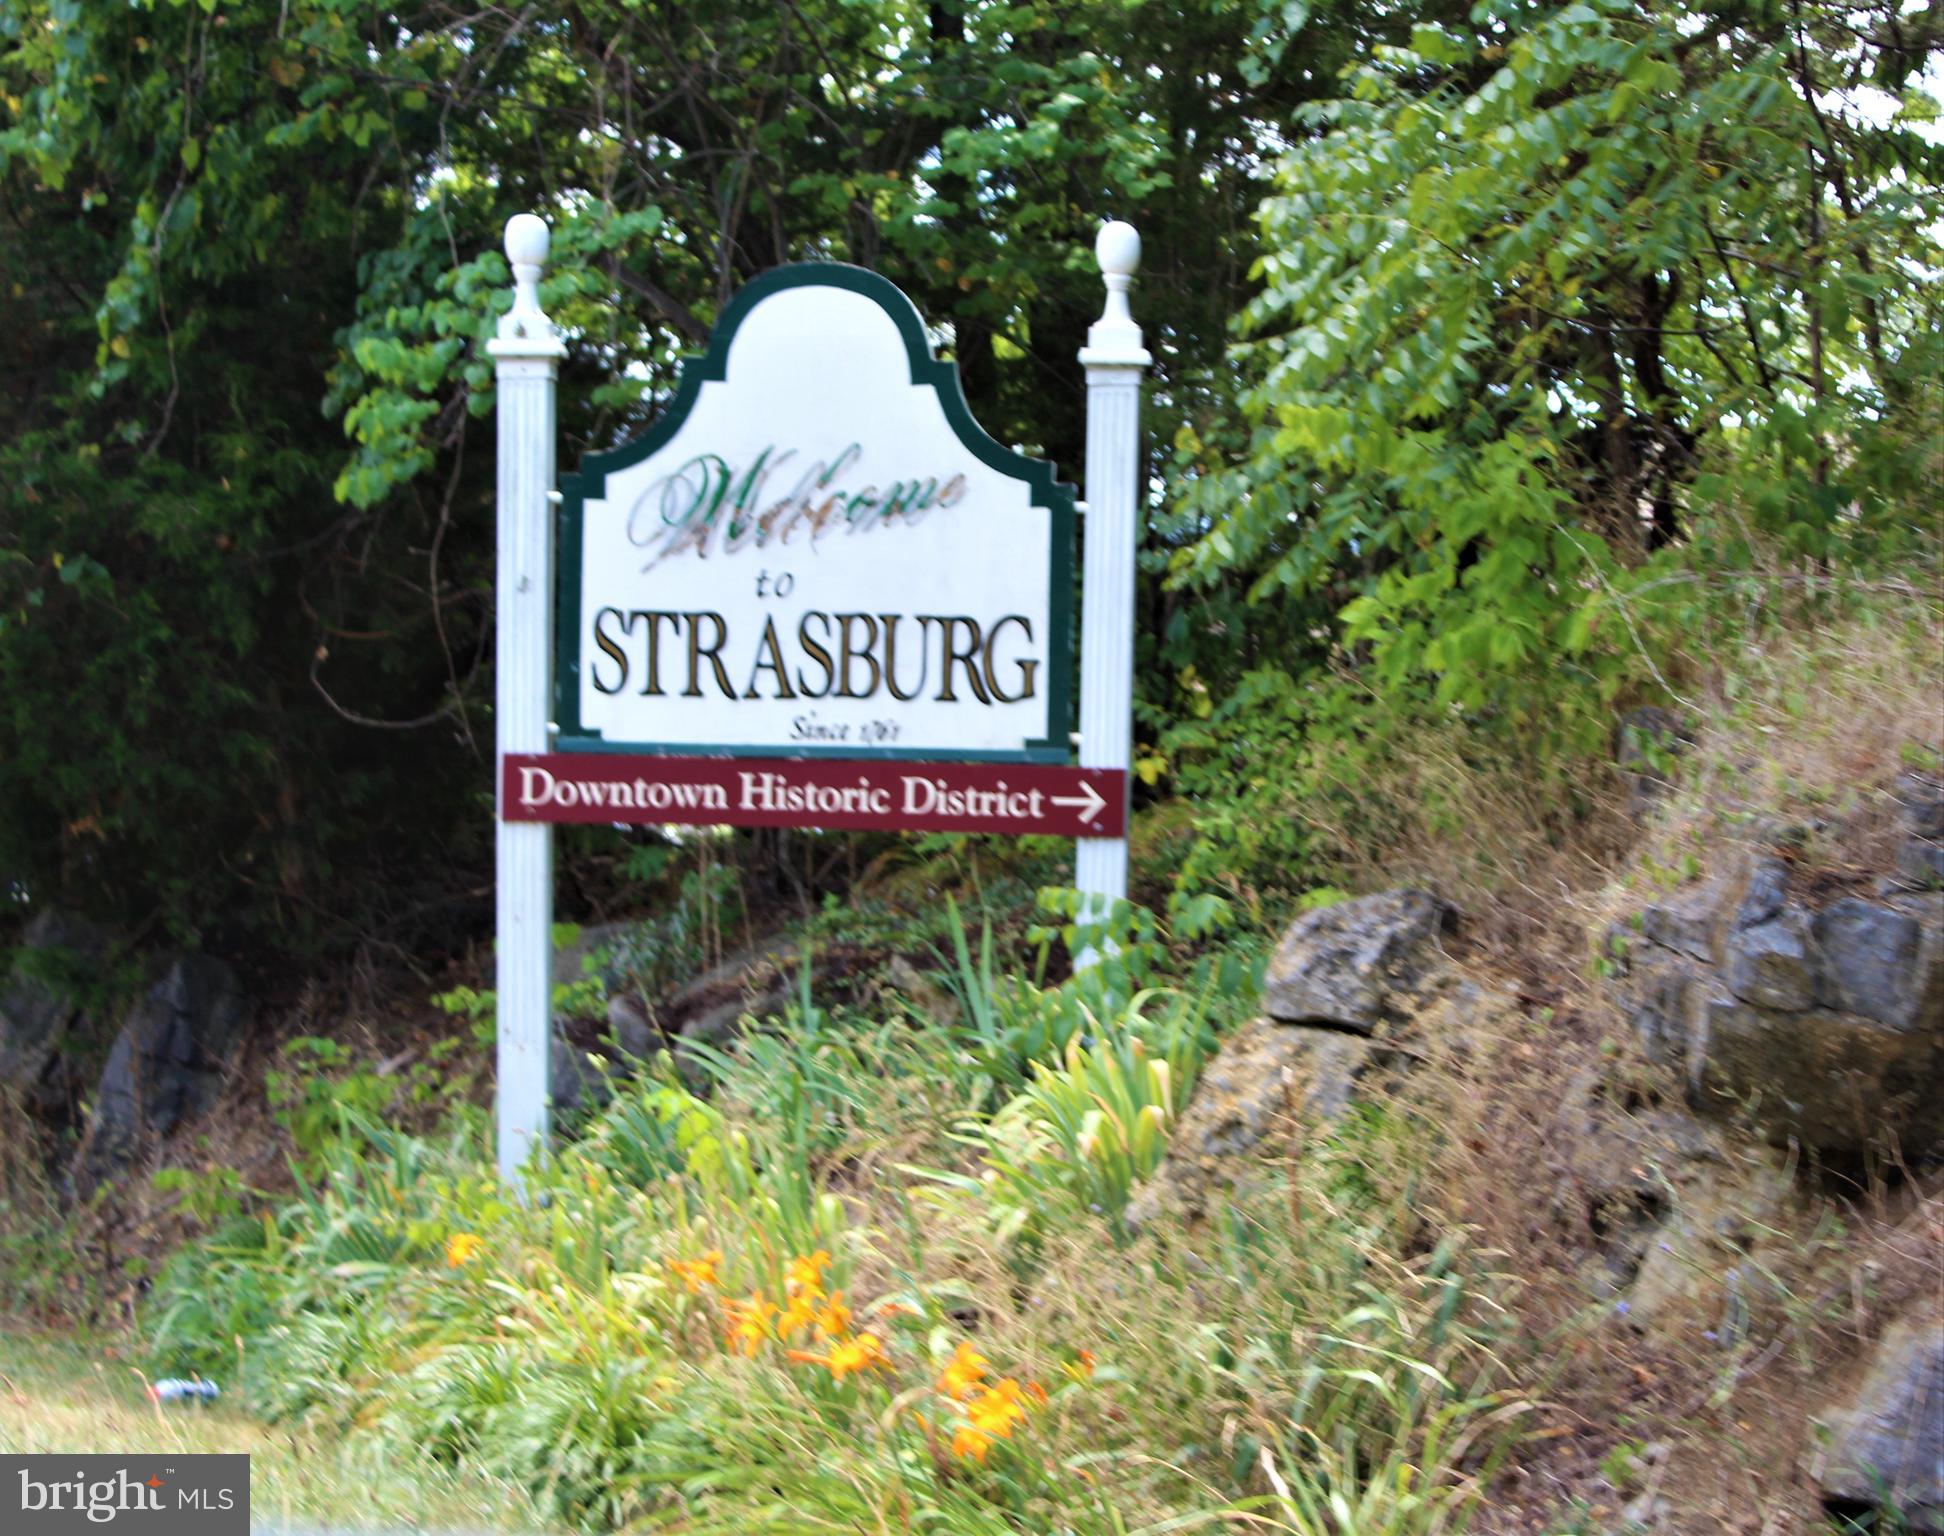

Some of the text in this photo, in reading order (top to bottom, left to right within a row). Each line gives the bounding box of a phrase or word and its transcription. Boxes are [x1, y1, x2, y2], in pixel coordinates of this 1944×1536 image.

[627, 443, 966, 574] Welcome
[756, 569, 795, 599] to
[592, 607, 1040, 705] STRASBURG
[790, 711, 849, 740] Since
[520, 766, 1044, 819] Downtown Historic District
